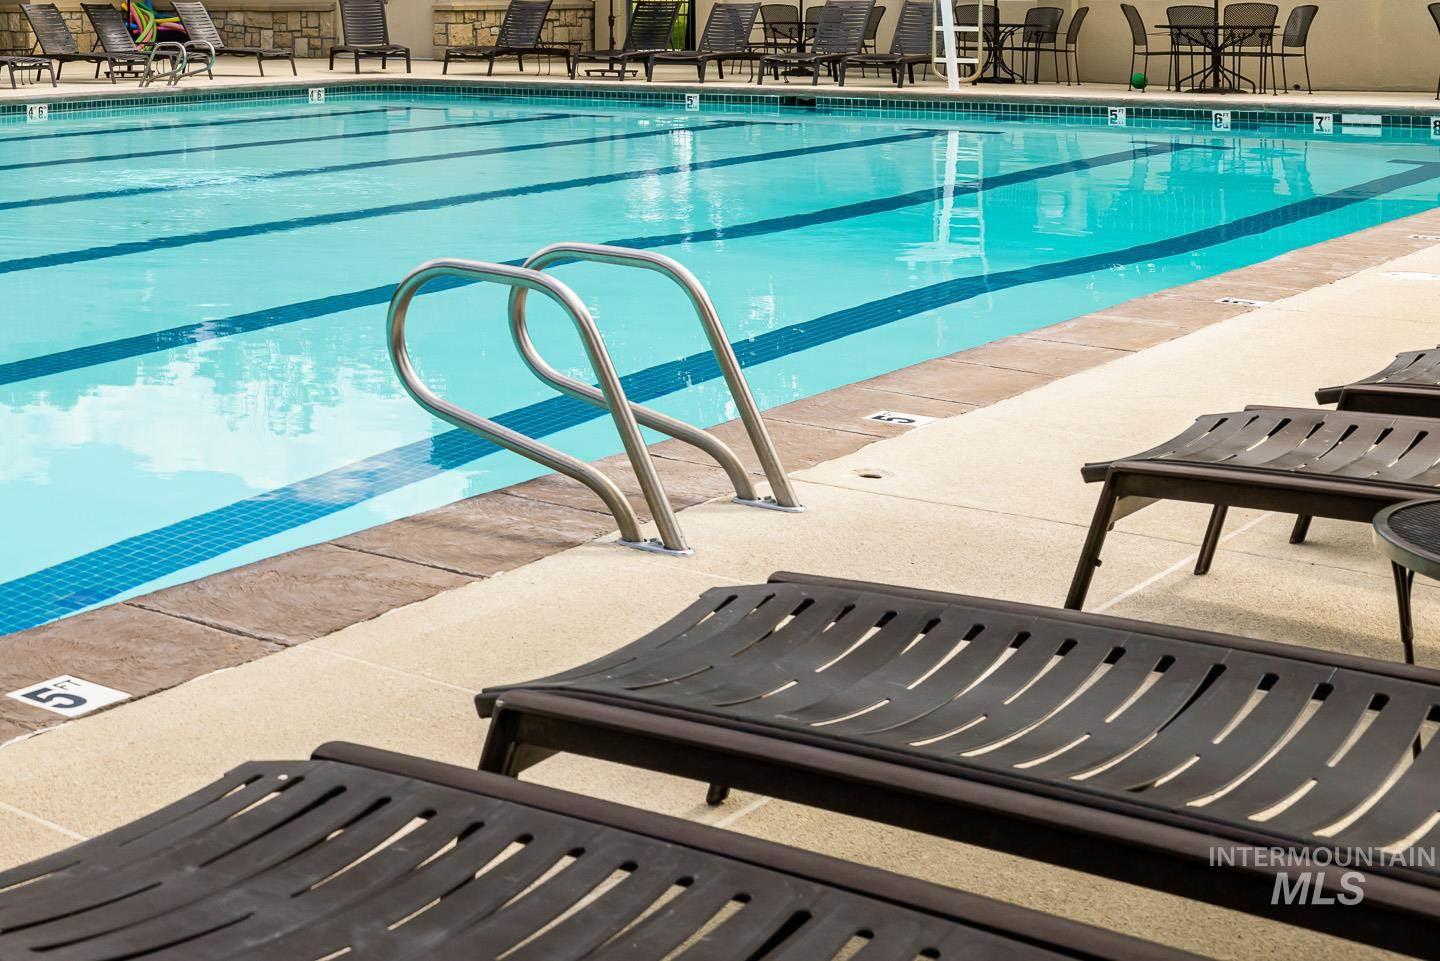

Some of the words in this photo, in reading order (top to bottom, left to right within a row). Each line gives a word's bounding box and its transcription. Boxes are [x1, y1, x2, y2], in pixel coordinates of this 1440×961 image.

[871, 415, 916, 424] 5
[53, 679, 81, 691] FT
[21, 687, 88, 709] 5
